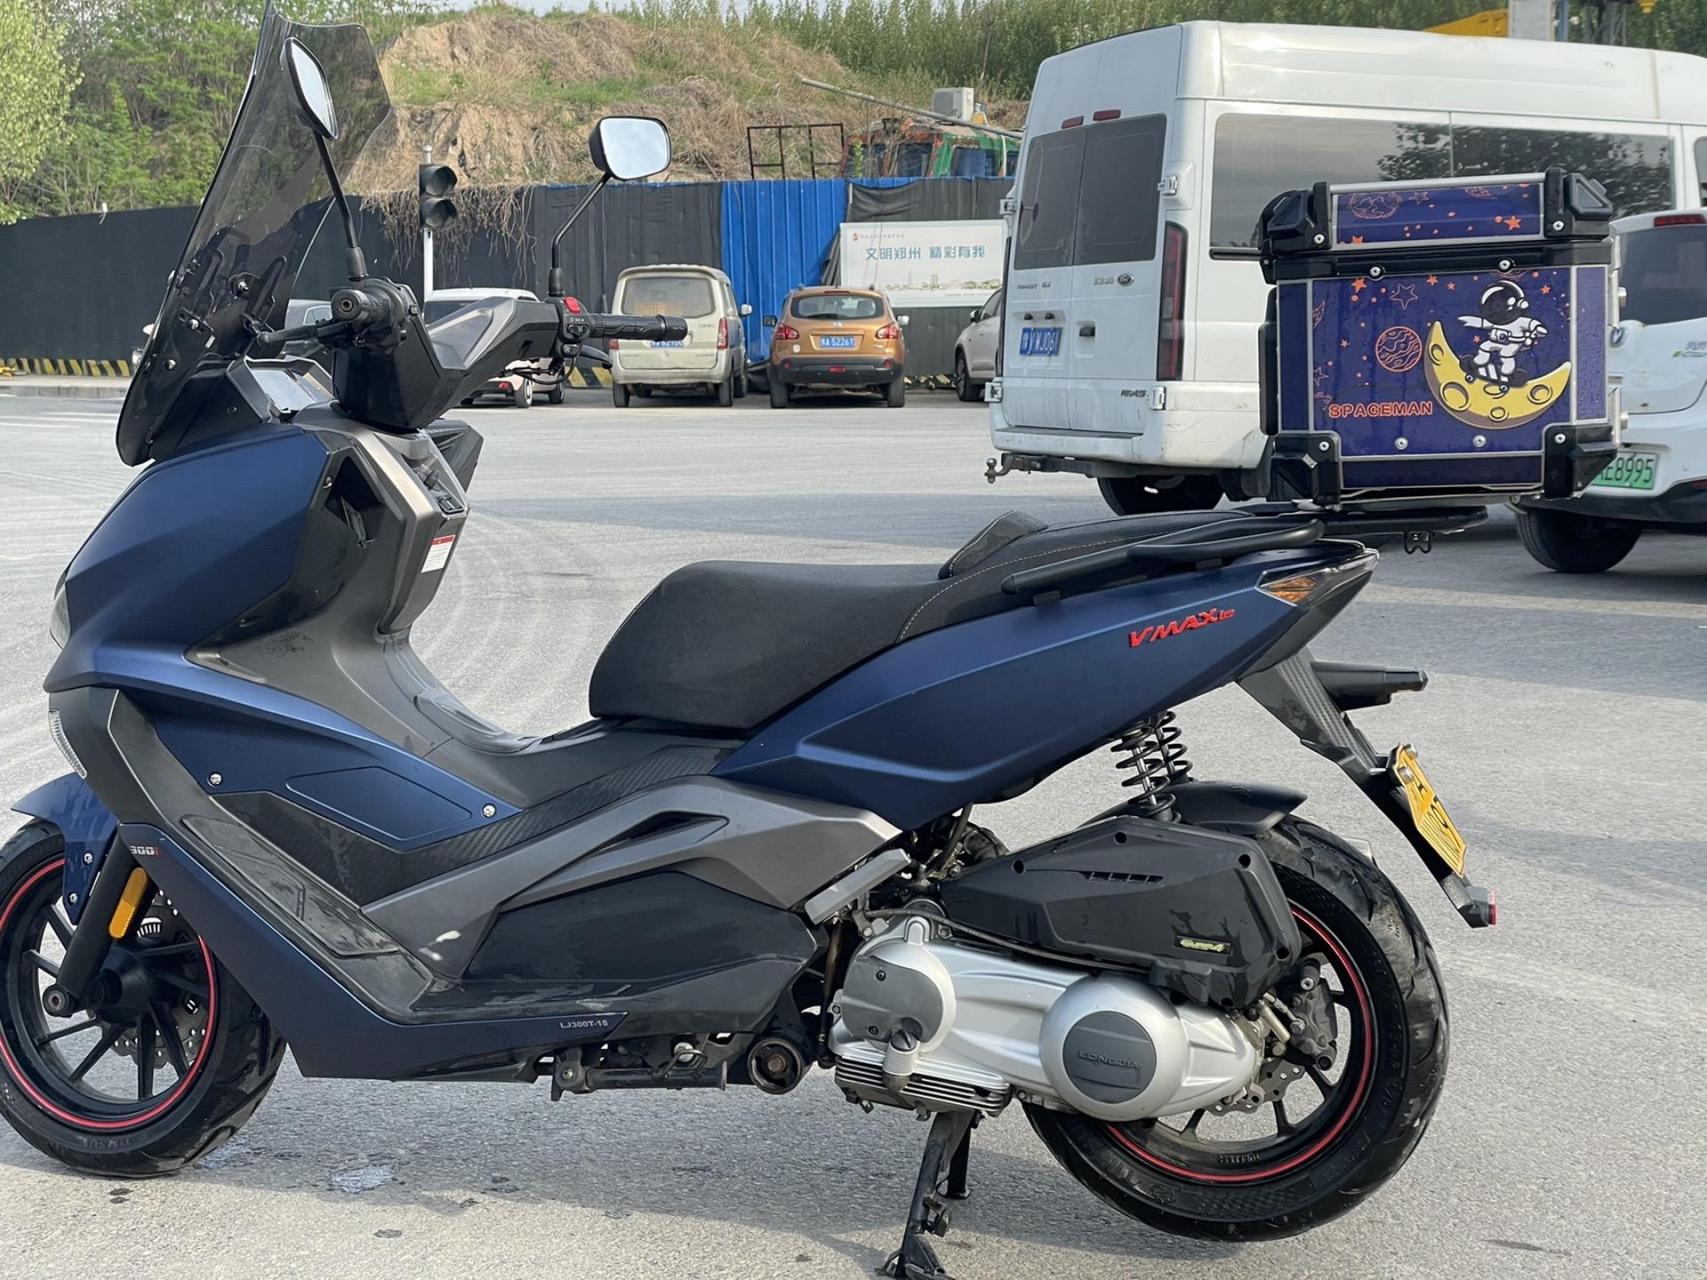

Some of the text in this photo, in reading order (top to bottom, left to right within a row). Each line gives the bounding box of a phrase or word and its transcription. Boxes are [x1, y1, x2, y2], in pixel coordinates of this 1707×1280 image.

[865, 245, 985, 261] 文明郑州 精彩有我
[1328, 401, 1433, 418] SPACEMAN
